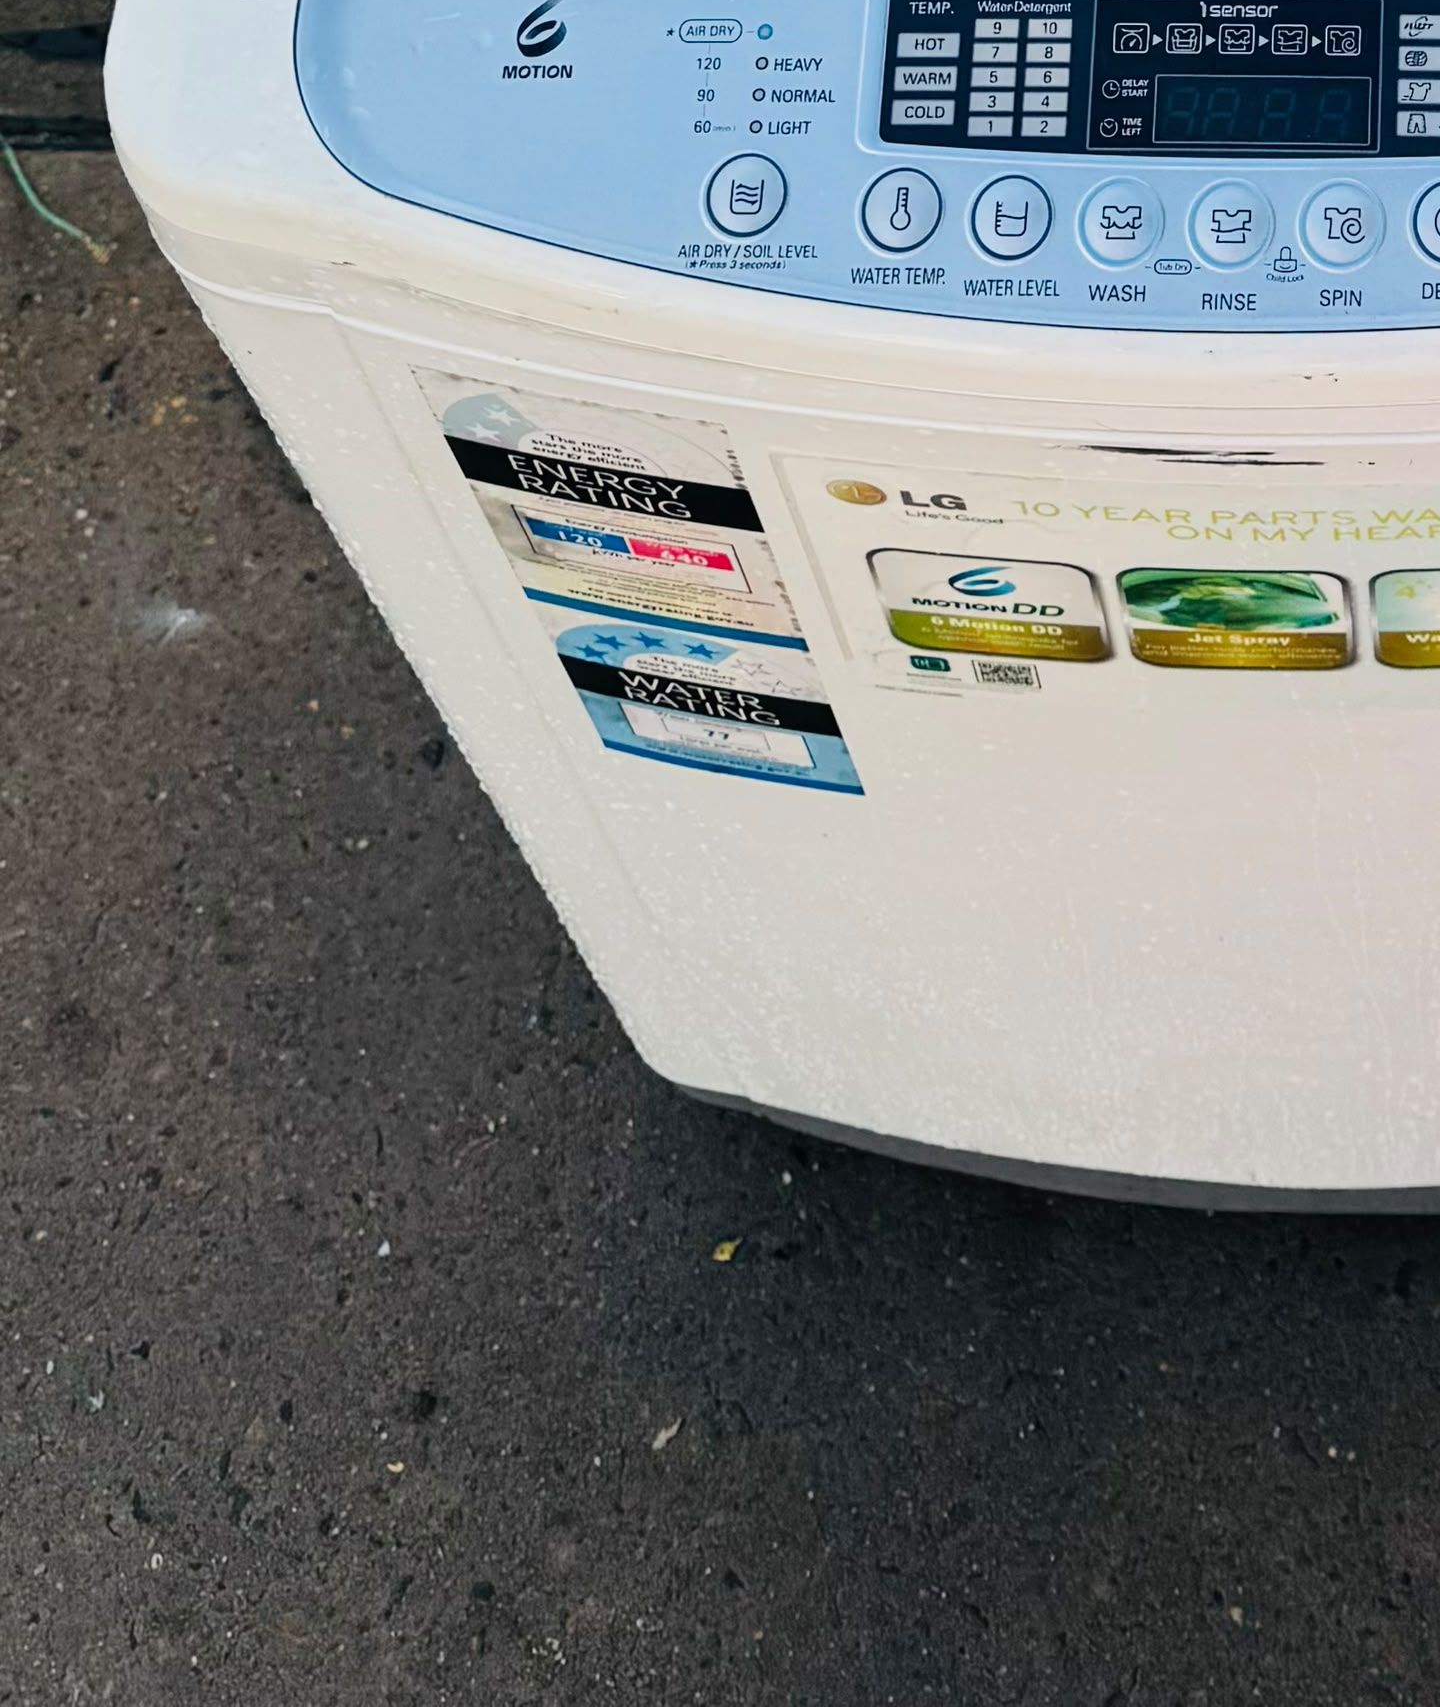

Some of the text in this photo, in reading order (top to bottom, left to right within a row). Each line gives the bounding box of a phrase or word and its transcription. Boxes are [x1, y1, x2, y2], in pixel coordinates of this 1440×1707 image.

[909, 1, 955, 16] TEMP.
[977, 0, 1072, 15] Water Detergent
[685, 24, 735, 38] AIR DRY
[993, 21, 1002, 35] 9
[1043, 21, 1058, 35] 10
[913, 37, 946, 51] HOT
[991, 46, 1000, 59] 7
[1044, 46, 1054, 59] 8
[695, 57, 722, 71] 120
[773, 57, 823, 72] HEAVY
[501, 64, 574, 80] MOTION
[902, 72, 952, 86] WARM
[989, 70, 998, 84] 5
[1043, 70, 1052, 84] 6
[1121, 78, 1149, 88] DELAY
[696, 89, 715, 103] 90
[770, 89, 836, 103] NORMAL
[1121, 88, 1149, 97] START
[987, 95, 997, 108] 3
[1041, 95, 1050, 108] 4
[903, 105, 946, 120] COLD
[693, 120, 711, 134] 60
[767, 120, 812, 135] LIGHT
[987, 120, 993, 133] 1
[1039, 120, 1049, 134] 2
[1122, 117, 1142, 126] TIME
[1121, 127, 1142, 136] LEFT
[677, 244, 700, 258] AIR
[704, 244, 732, 258] DRY
[743, 244, 774, 259] SOIL
[778, 245, 818, 259] LEVEL
[850, 267, 946, 285] WATER TEMP.
[963, 278, 1060, 298] WATER LEVEL
[1088, 285, 1147, 303] WASH
[1201, 292, 1257, 311] RINSE
[1318, 289, 1363, 308] SPIN
[507, 454, 684, 500] ENERGY
[518, 473, 692, 519] RATING
[899, 490, 968, 511] LG
[904, 510, 1004, 525] Life's Good
[1010, 500, 1060, 518] 10
[1072, 505, 1192, 524] YEAR
[1210, 509, 1357, 525] PARTS
[1166, 524, 1234, 541] ON
[1252, 527, 1316, 542] MY
[911, 597, 1065, 617] MOTION DD
[949, 616, 1025, 633] Motion
[1031, 624, 1063, 636] DD
[1188, 633, 1291, 647] Jet Spray
[618, 670, 765, 710] WATER
[624, 686, 781, 727] RATING
